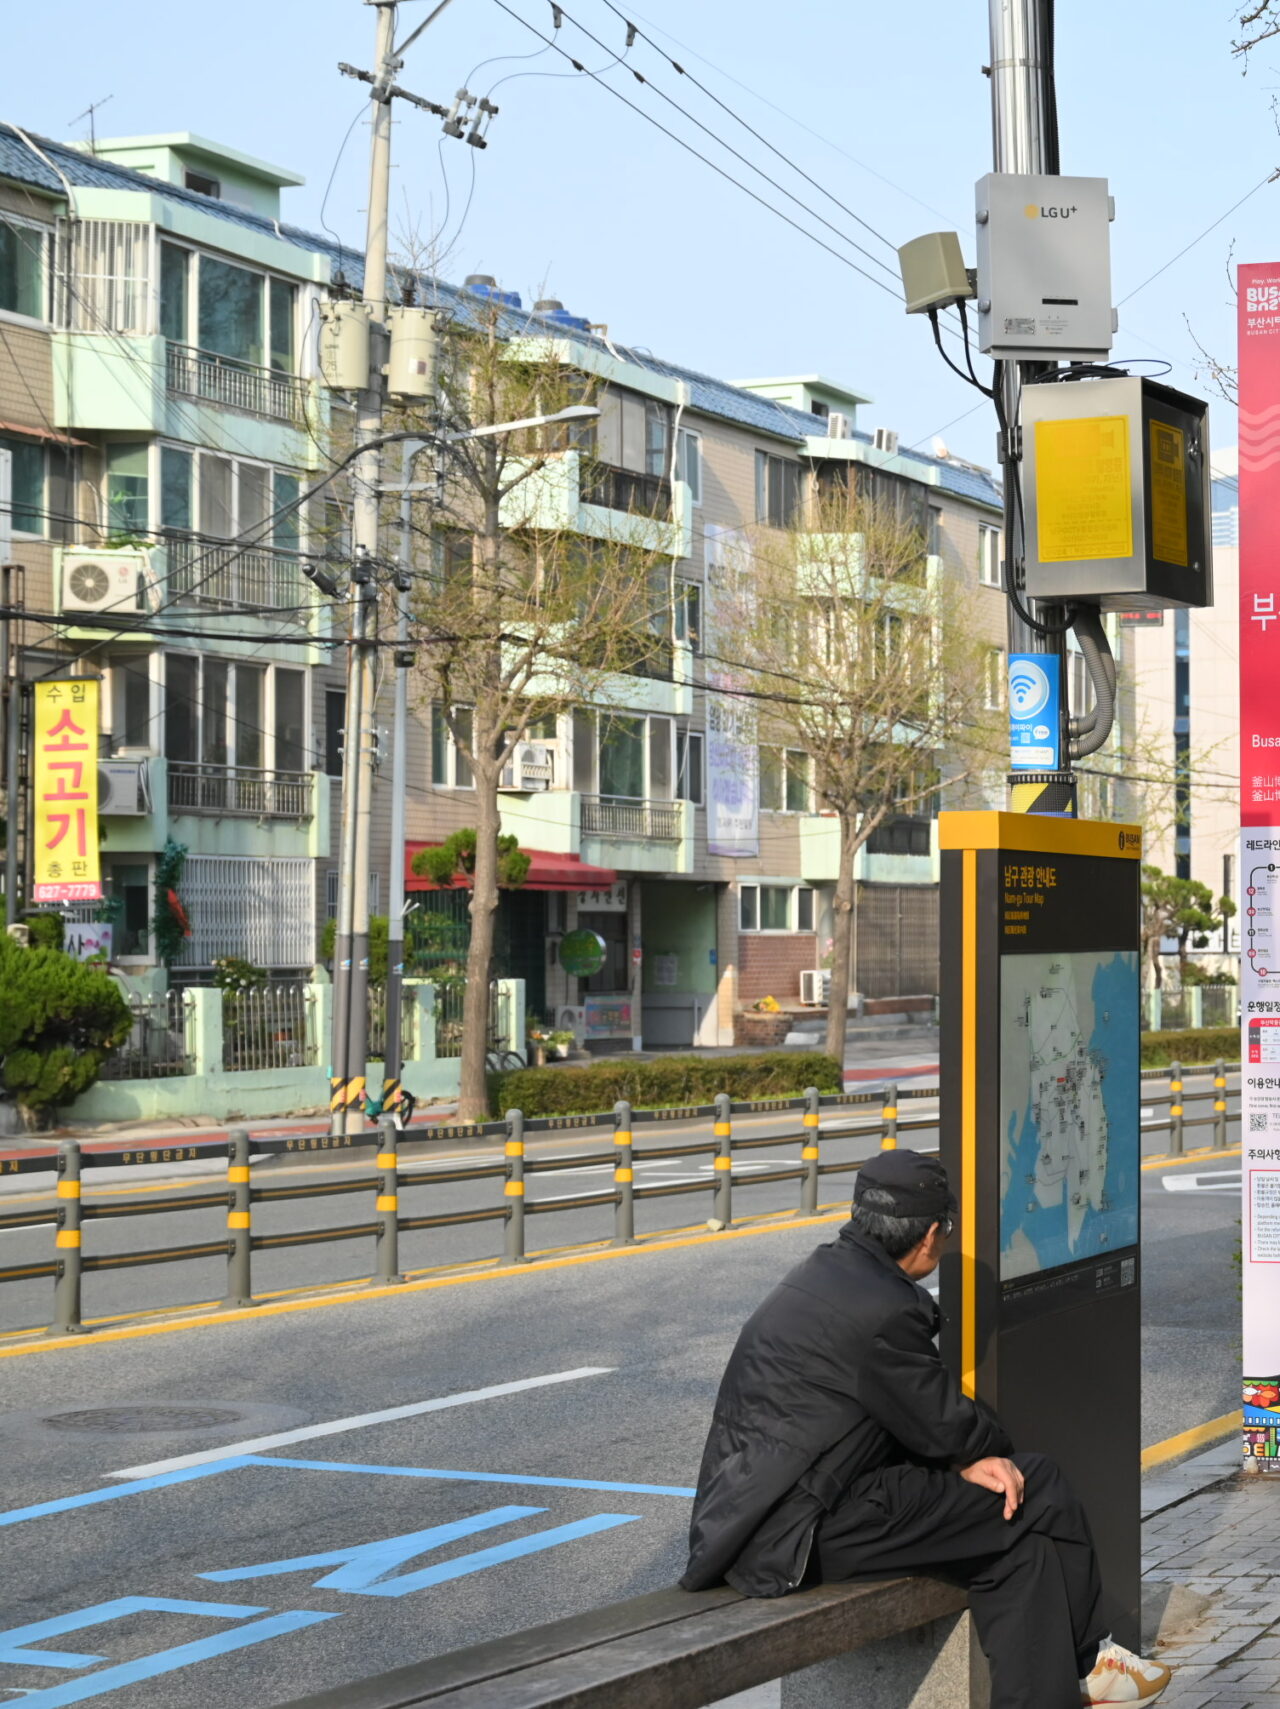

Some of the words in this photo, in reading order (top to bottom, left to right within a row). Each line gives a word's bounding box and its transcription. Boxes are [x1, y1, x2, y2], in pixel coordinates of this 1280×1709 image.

[1041, 207, 1058, 218] LG
[46, 685, 86, 704] 수입
[43, 709, 89, 857] 소고기
[1246, 840, 1280, 850] 레드라인
[1004, 865, 1018, 887] 남구
[1020, 866, 1034, 888] 관광
[1036, 866, 1056, 888] 안내도
[38, 883, 96, 899] 627-7779
[426, 1126, 483, 1140] 무단횡단금지
[286, 1136, 352, 1151] 무단횡단금지
[122, 1148, 197, 1164] 무단횡단금지
